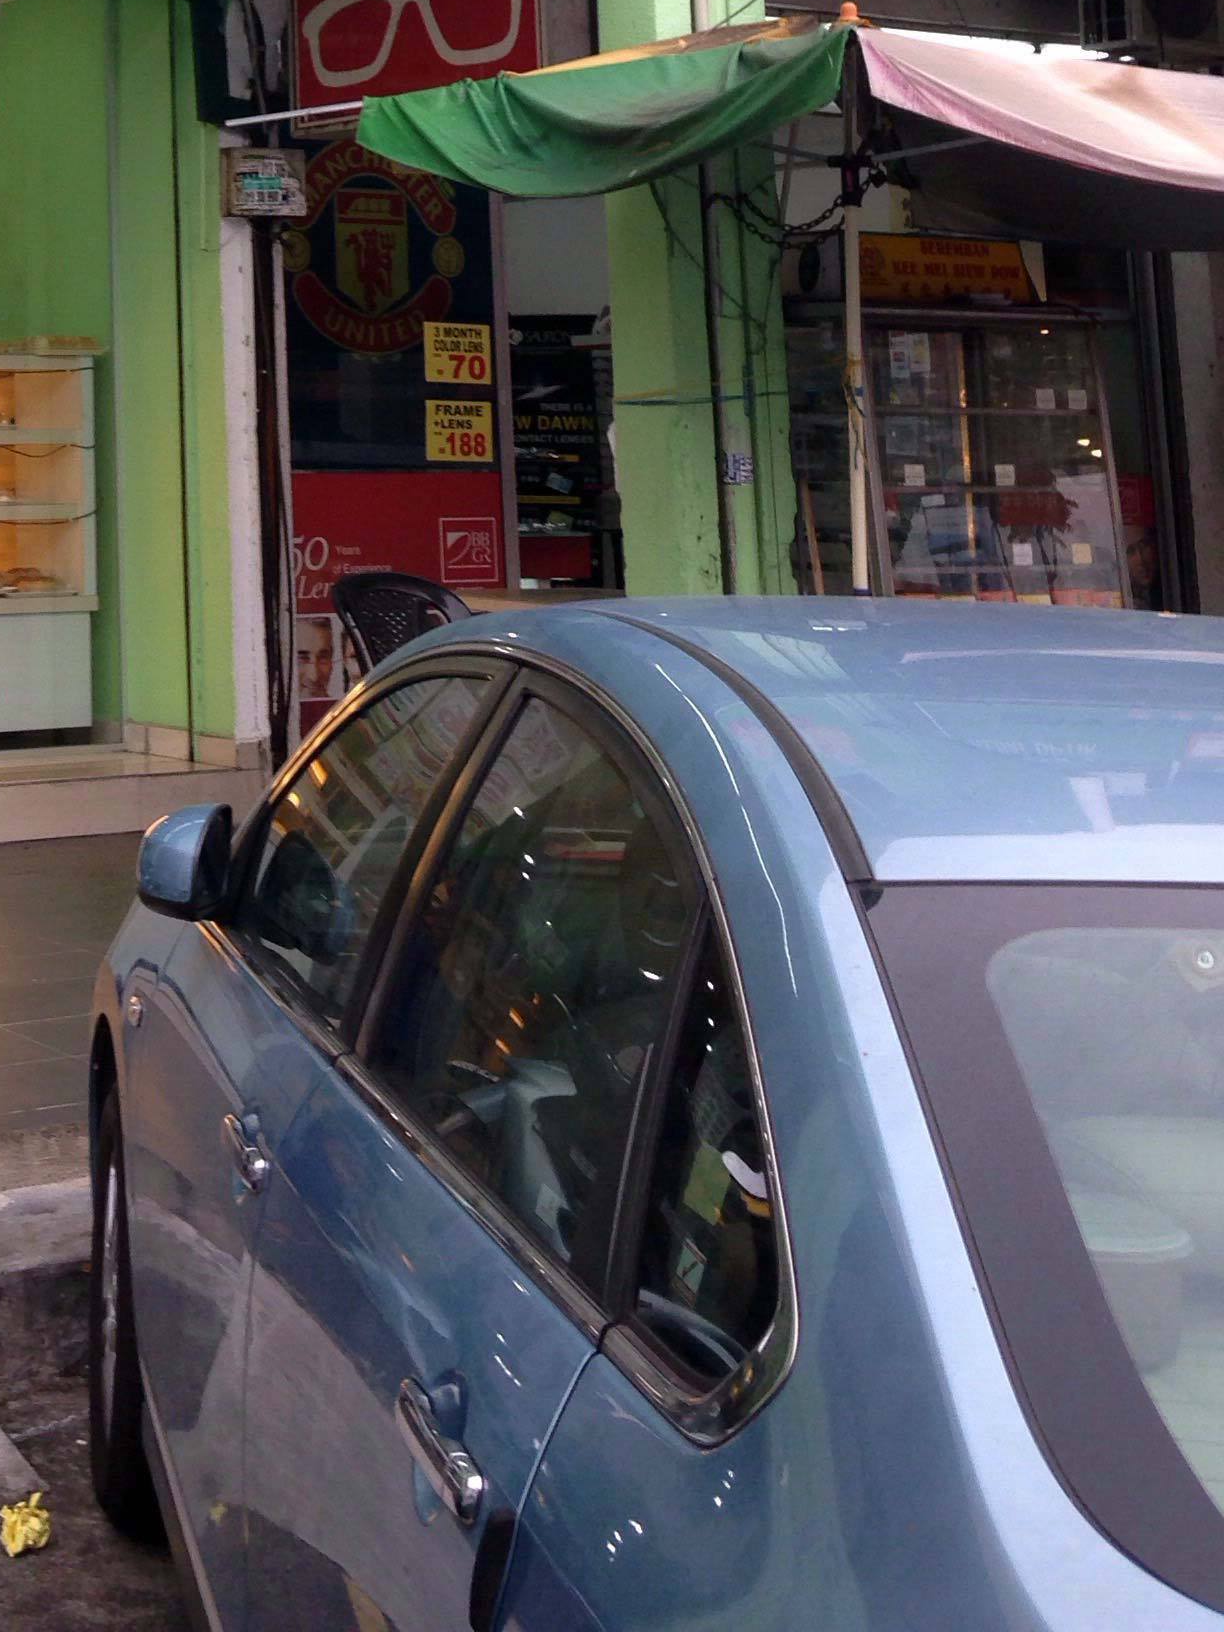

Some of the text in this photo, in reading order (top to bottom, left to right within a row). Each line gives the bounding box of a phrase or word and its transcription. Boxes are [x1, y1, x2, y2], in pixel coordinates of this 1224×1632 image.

[323, 306, 424, 346] UNITED
[444, 328, 483, 340] MONTH
[434, 339, 484, 354] COLOR LENS
[435, 404, 484, 417] FRAME
[537, 416, 594, 430] DAWN
[335, 545, 361, 556] Years
